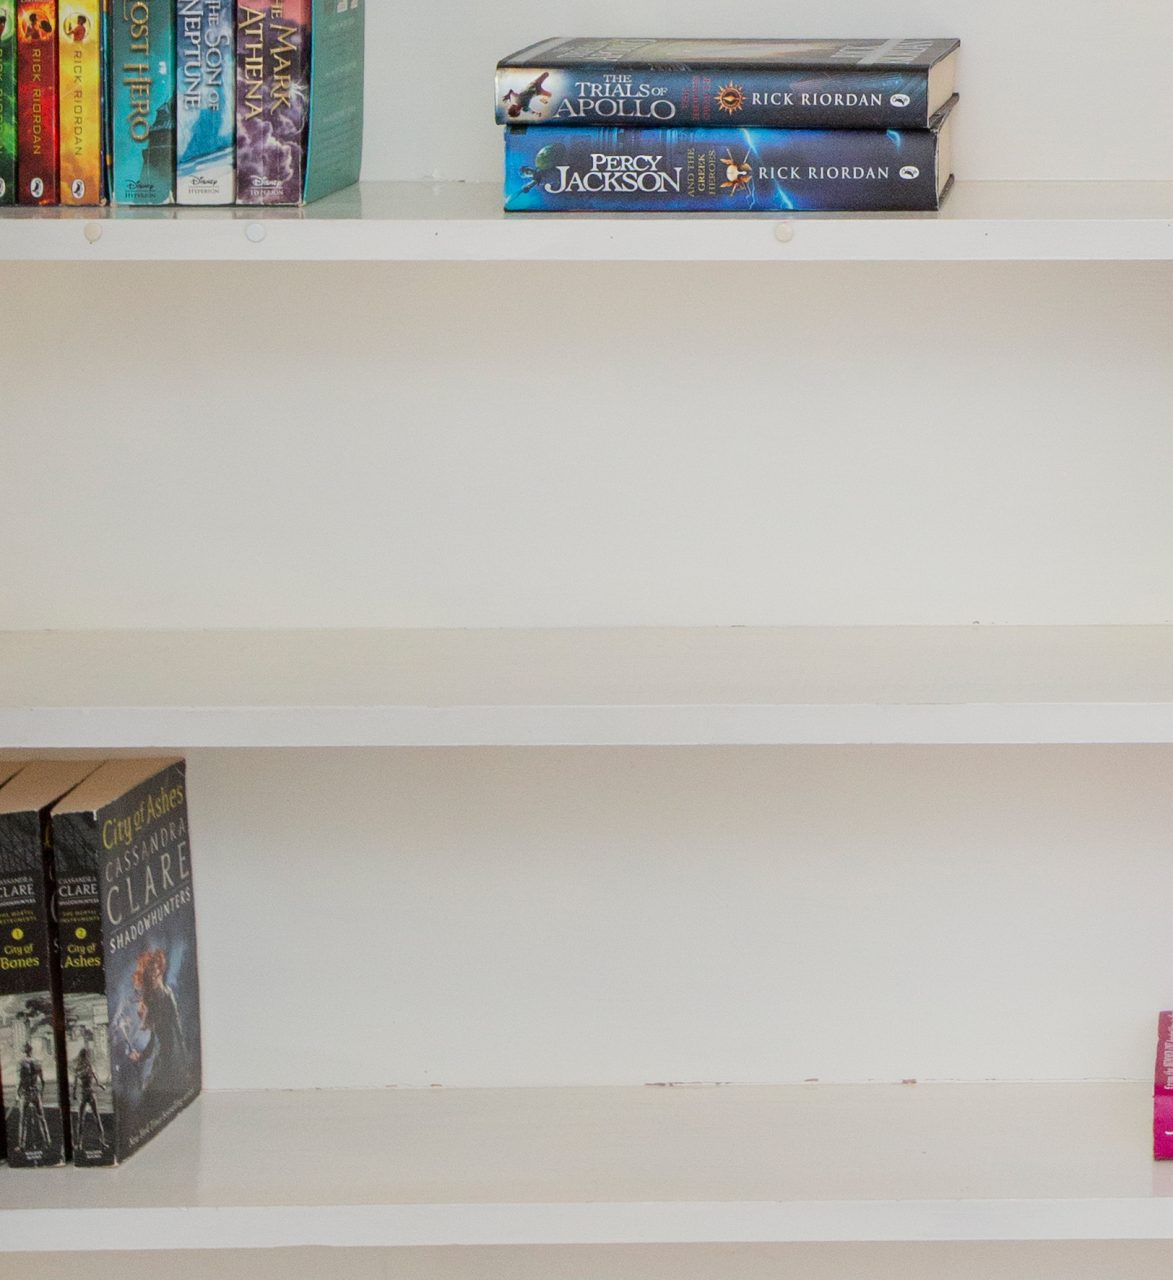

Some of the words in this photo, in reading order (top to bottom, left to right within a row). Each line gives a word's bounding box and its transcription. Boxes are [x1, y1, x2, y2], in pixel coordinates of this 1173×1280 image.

[32, 48, 42, 82] RICK
[73, 50, 83, 83] RICK
[204, 28, 230, 87] SON
[237, 5, 267, 121] ATHENA
[269, 23, 298, 116] MARK
[575, 81, 650, 98] TRIALS
[651, 87, 669, 96] OF
[602, 74, 632, 83] THE
[122, 63, 152, 143] HERO
[209, 89, 219, 112] OF
[553, 98, 676, 120] APOLLO
[752, 92, 794, 105] RICK
[801, 93, 882, 106] RIORDAN
[32, 88, 42, 155] RIORDAN
[73, 90, 83, 156] RIORDAN
[590, 153, 663, 172] PERCY
[687, 147, 695, 170] THE
[697, 153, 705, 192] GREEK
[708, 148, 716, 196] HEROES
[759, 166, 801, 180] RICK
[808, 166, 889, 180] RIORDAN
[544, 166, 683, 195] JACKSON
[687, 173, 695, 198] AND
[102, 813, 133, 850] City
[134, 801, 145, 831] of
[147, 784, 185, 825] Ashes
[105, 817, 186, 883] CASSANDRA
[58, 883, 98, 897] CLARE
[106, 841, 190, 925] CLARE
[109, 886, 192, 954] SHADOWHUNTERS
[4, 945, 23, 955] City
[24, 943, 34, 954] of
[64, 955, 101, 969] Ashes
[67, 945, 85, 954] City
[87, 942, 97, 953] of
[0, 957, 40, 970] Bones
